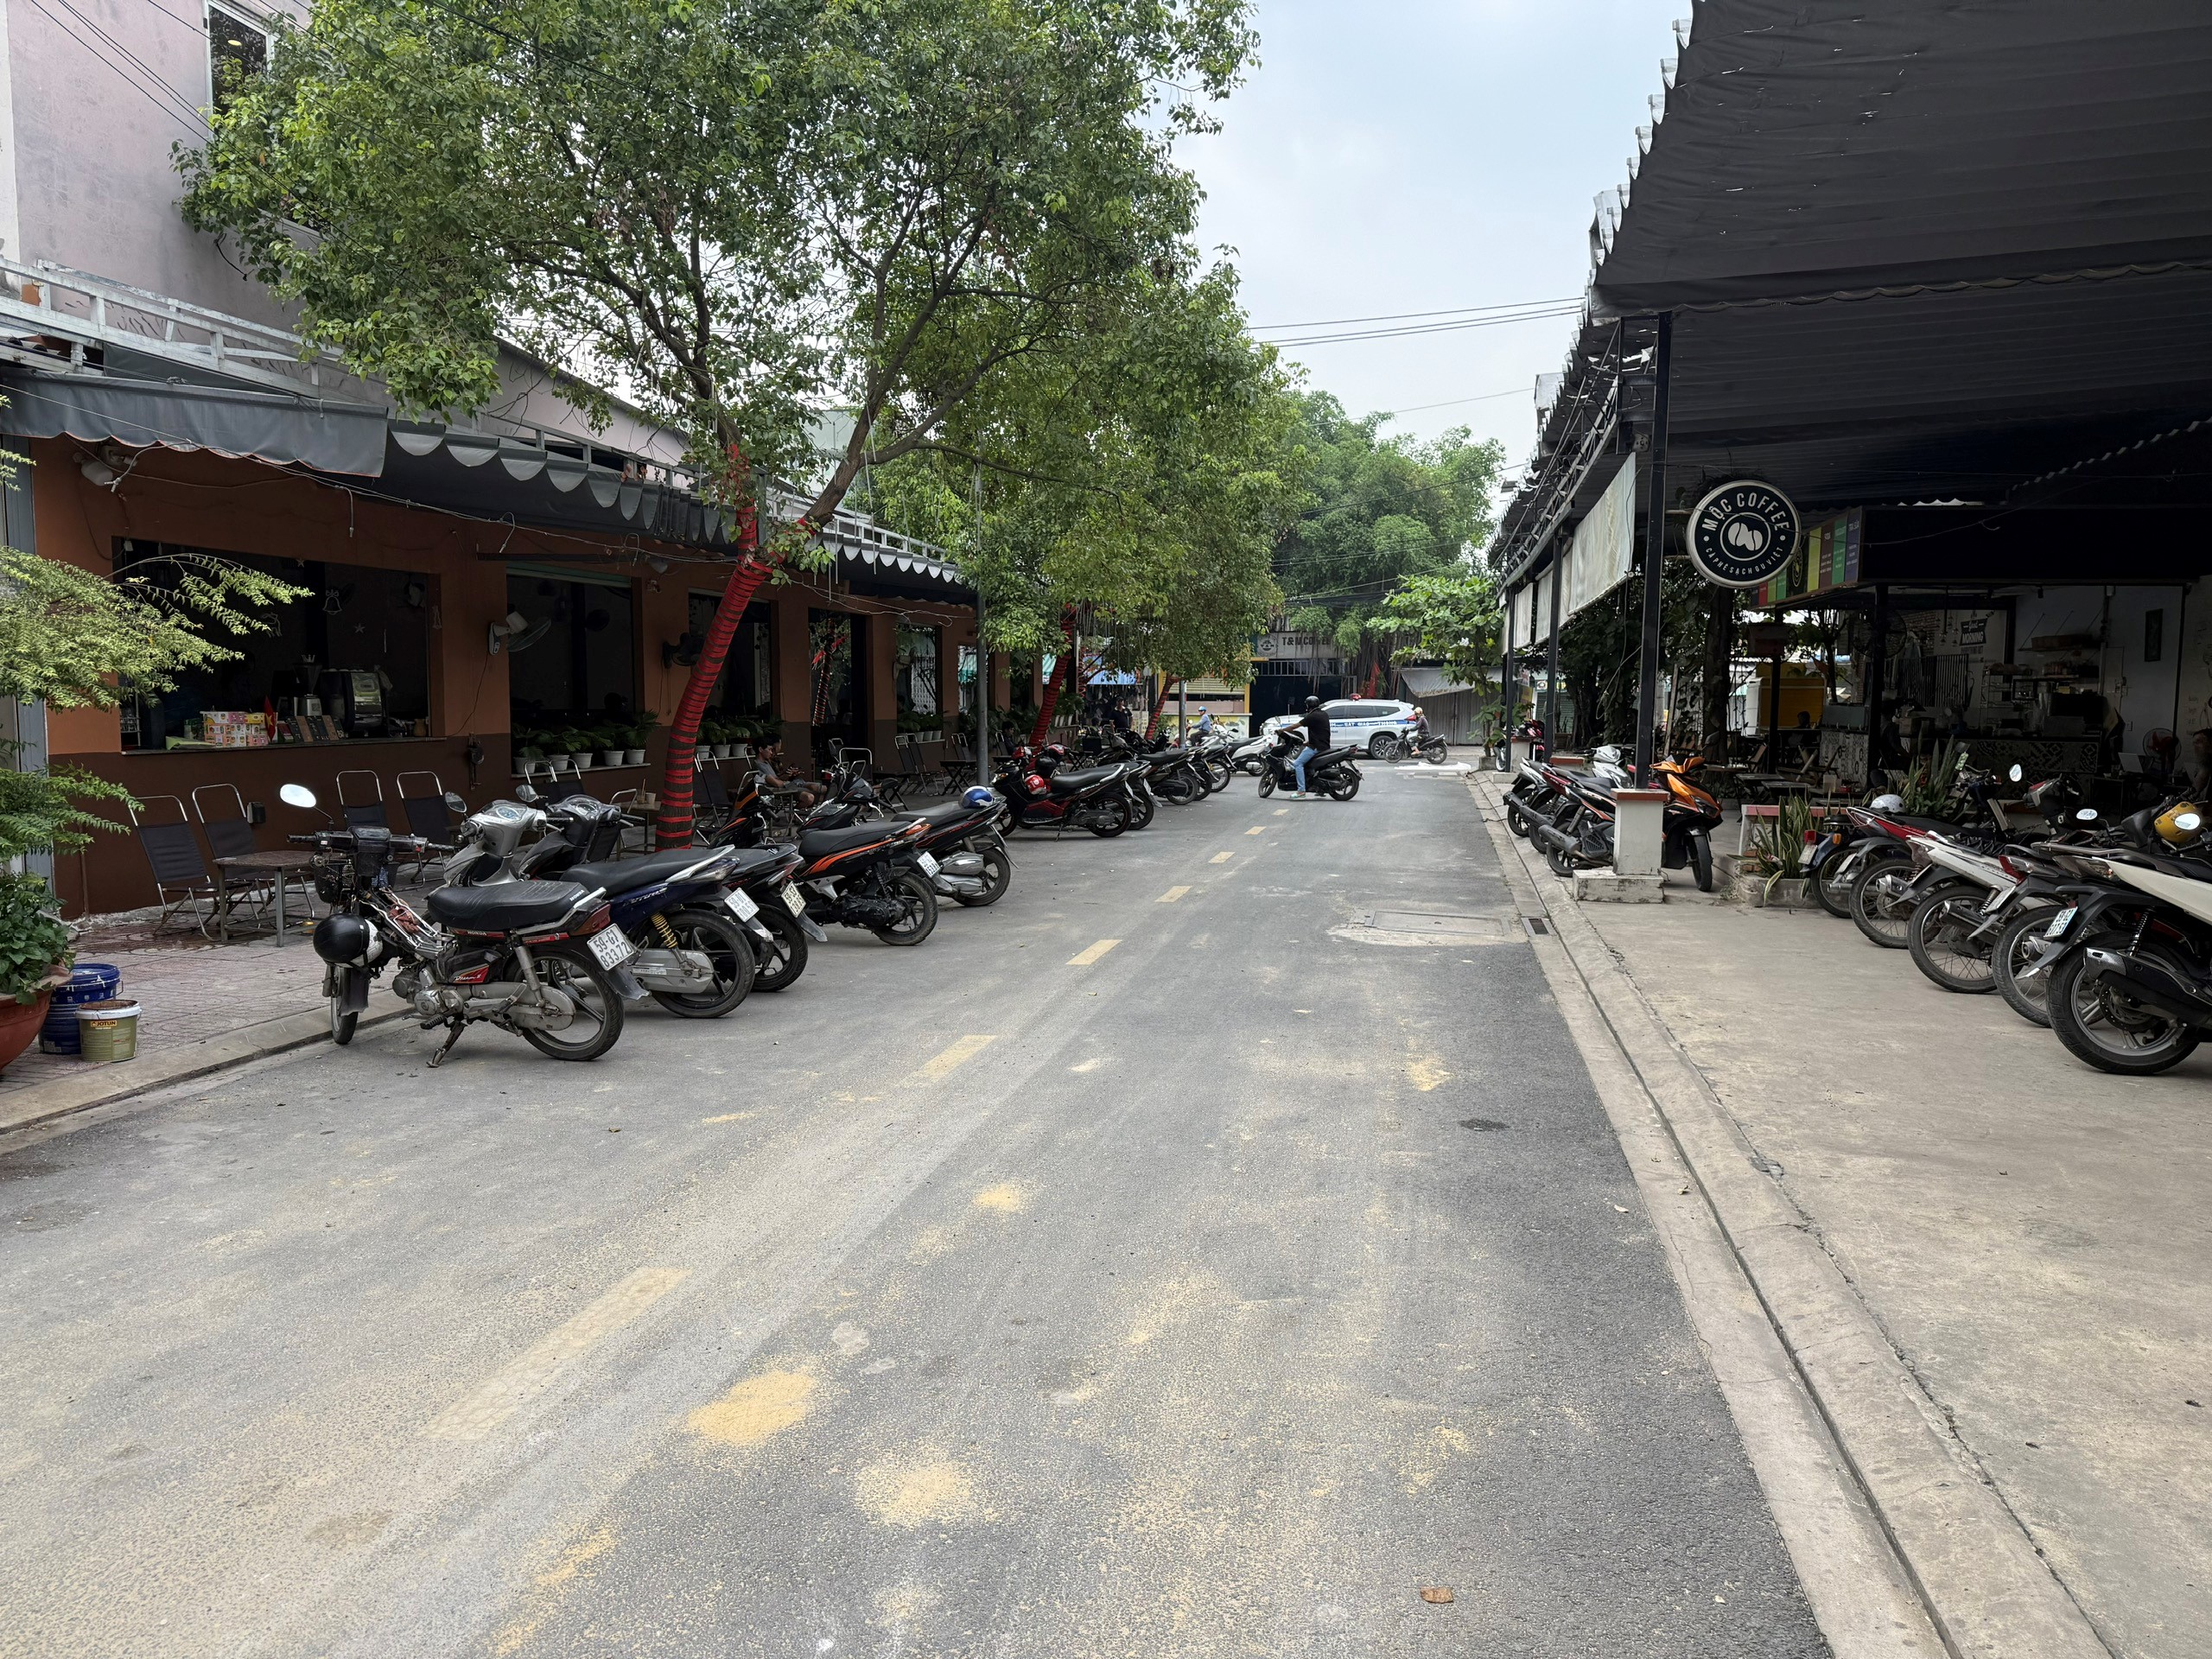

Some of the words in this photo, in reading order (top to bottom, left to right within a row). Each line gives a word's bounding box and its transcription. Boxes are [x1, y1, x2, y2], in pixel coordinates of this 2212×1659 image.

[1701, 499, 1732, 531] MỘC
[1737, 492, 1790, 531] COFFEE
[569, 889, 585, 901] HONDA
[600, 941, 629, 968] 833.72
